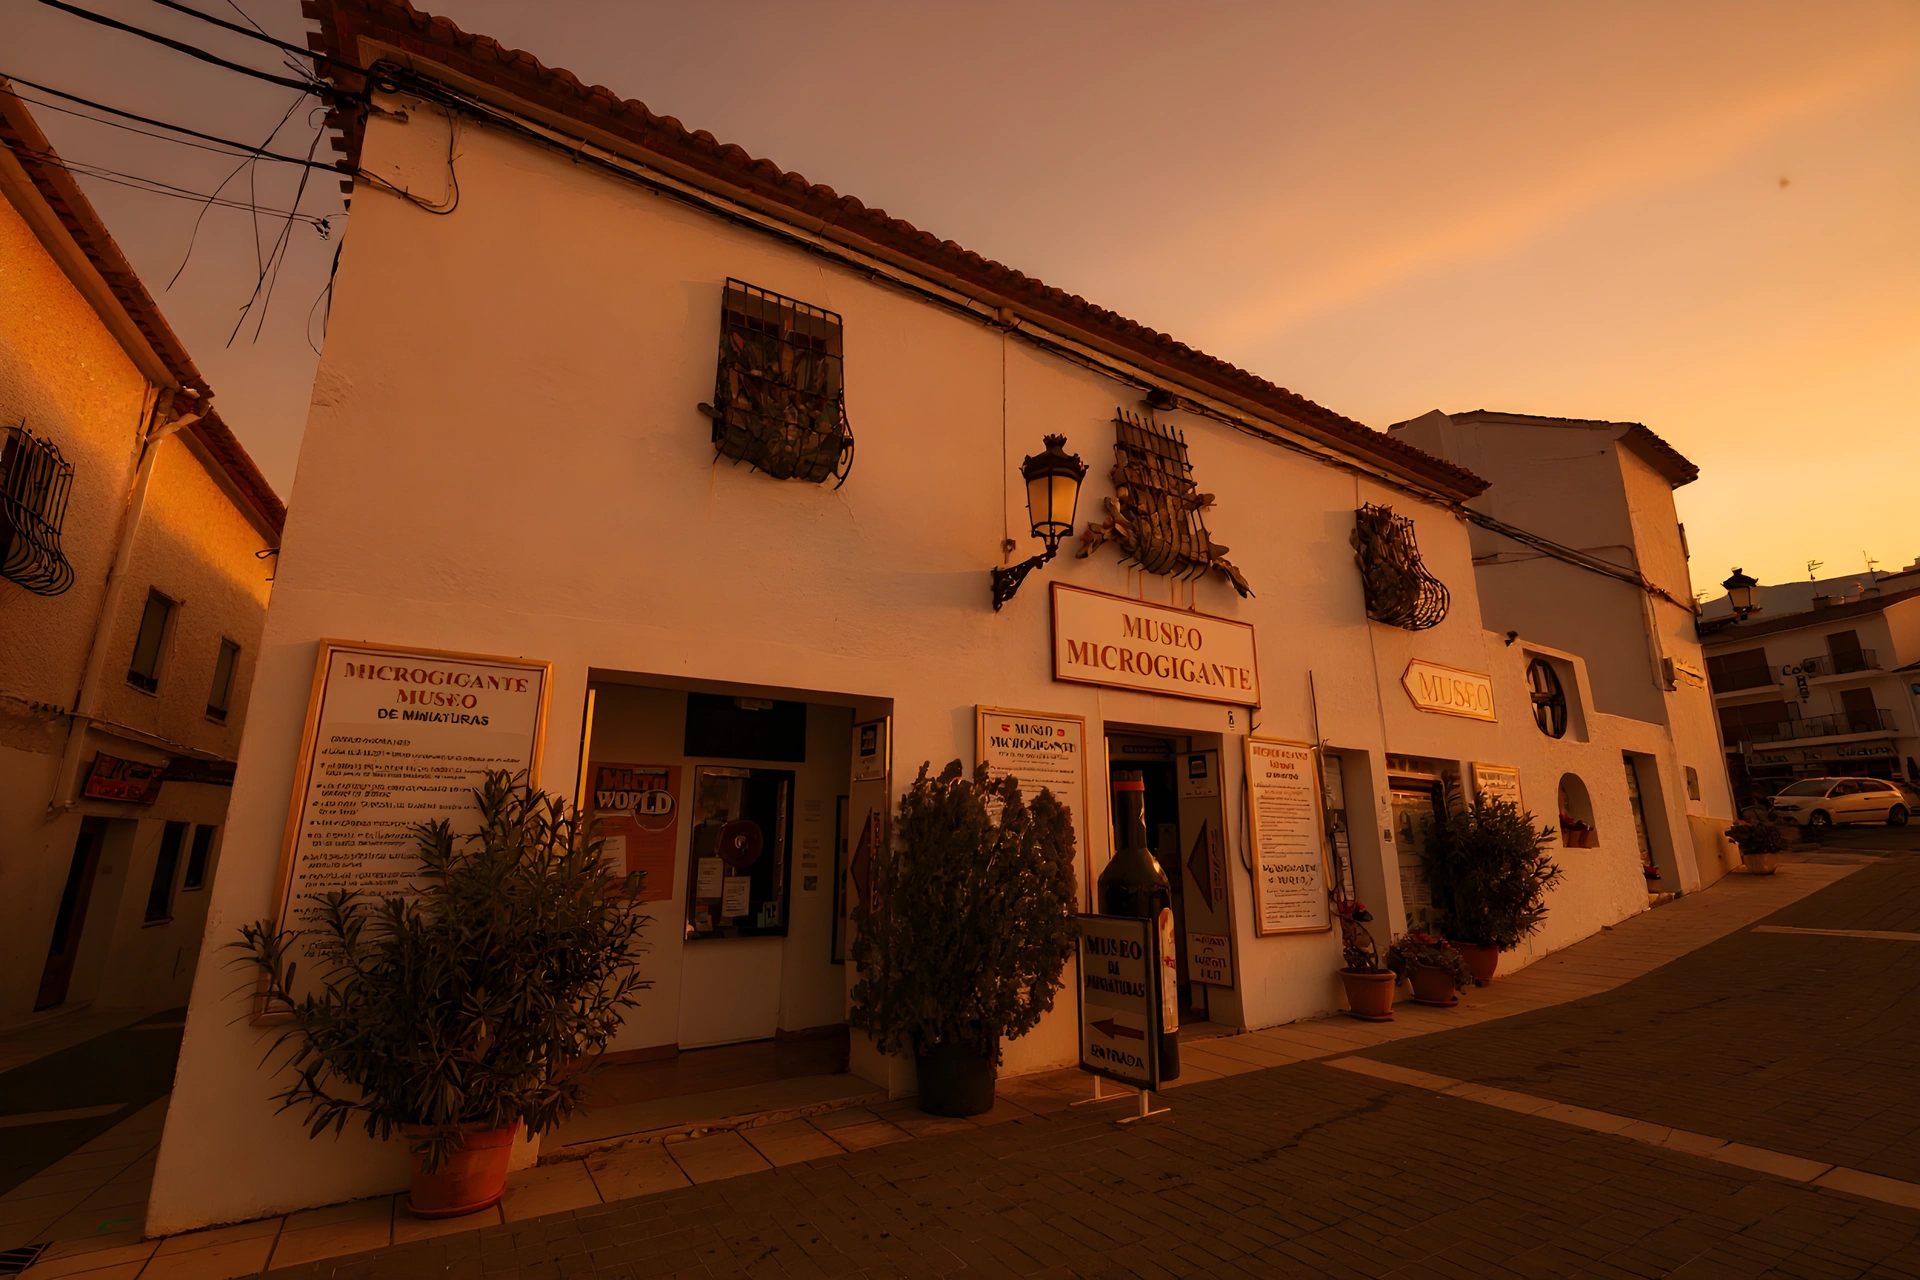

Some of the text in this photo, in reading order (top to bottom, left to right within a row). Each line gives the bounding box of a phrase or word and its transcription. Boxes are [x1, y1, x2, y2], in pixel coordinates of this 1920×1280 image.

[1122, 614, 1202, 651] MUSEO
[344, 662, 529, 693] MICROGIGANTE
[1066, 638, 1252, 690] MICROGIGANTE
[396, 689, 478, 710] MUSEO
[1419, 671, 1490, 711] MUSEO
[377, 707, 489, 726] DE MINIATURAS
[596, 789, 672, 815] WORLD
[1086, 934, 1143, 961] MUSEO
[1091, 1043, 1145, 1070] ENTRADA
